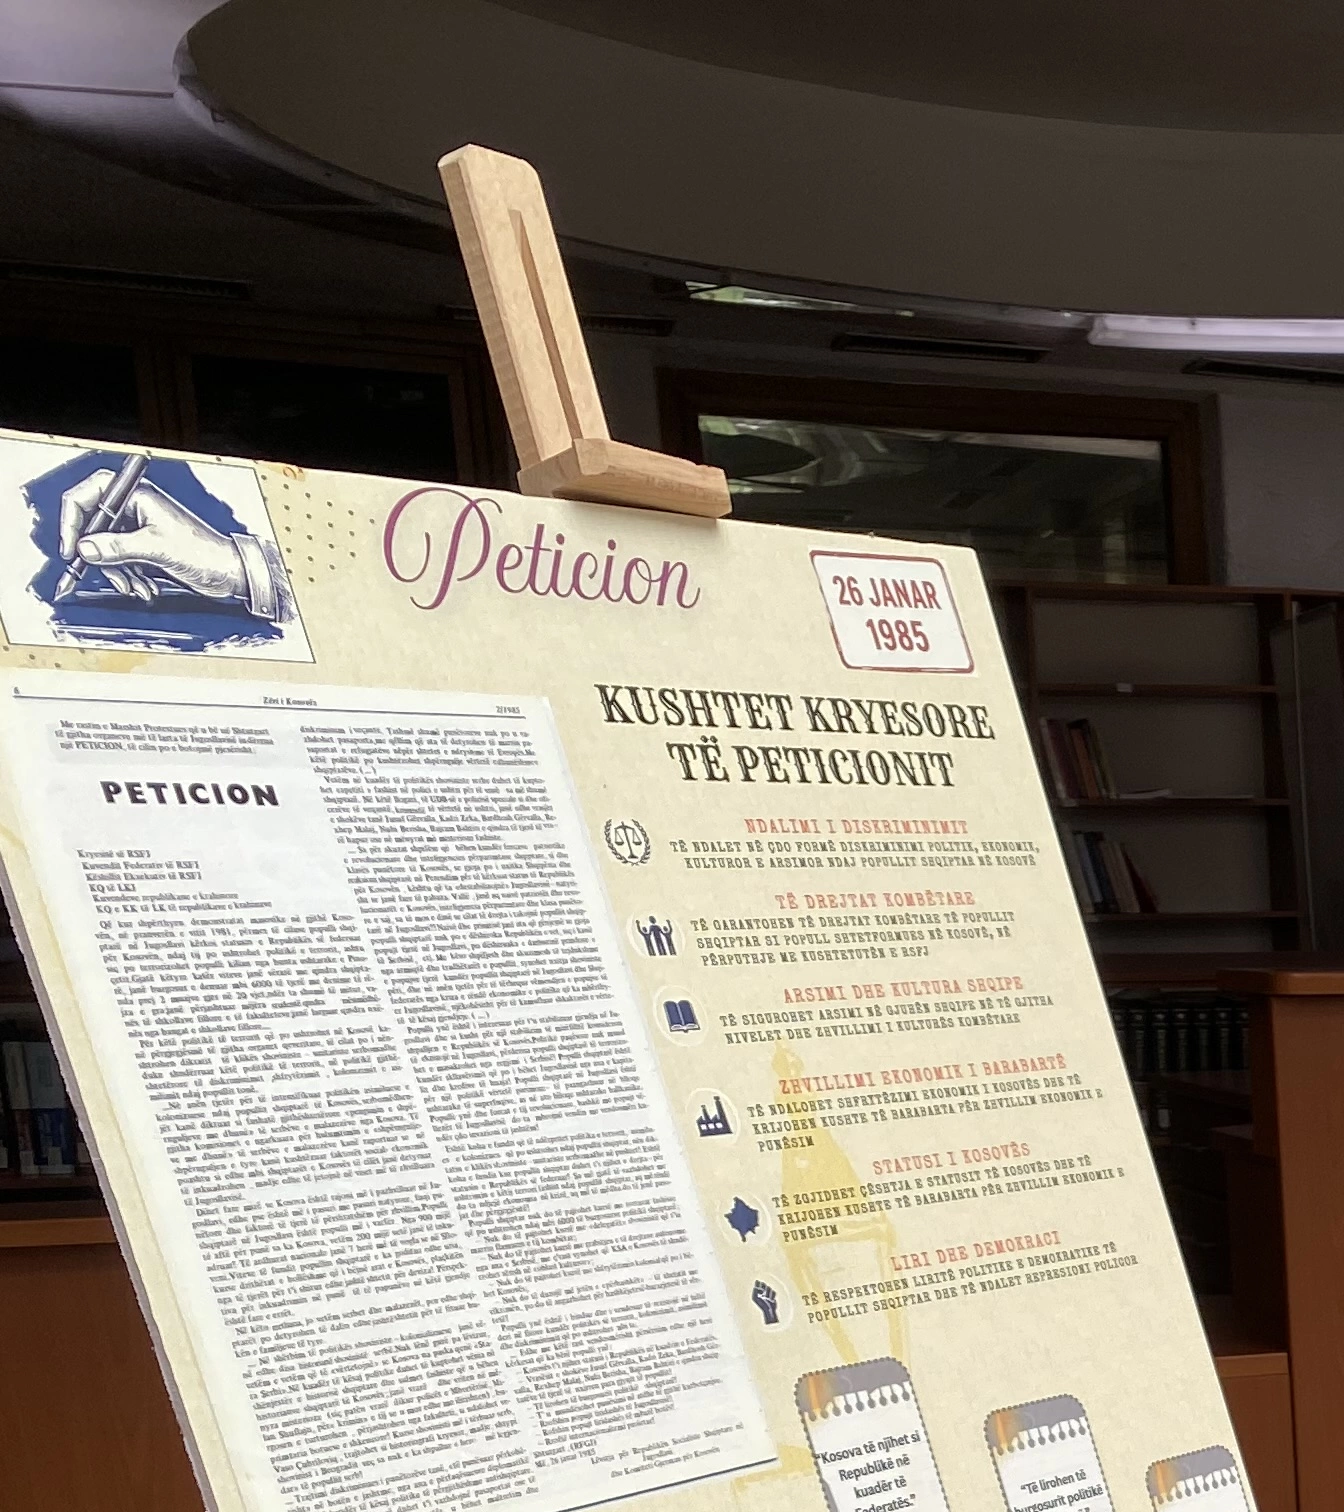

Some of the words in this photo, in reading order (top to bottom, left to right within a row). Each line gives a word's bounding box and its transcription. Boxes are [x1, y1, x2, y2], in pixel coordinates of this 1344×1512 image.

[383, 487, 698, 608] Peticion
[832, 575, 863, 605] 26
[869, 577, 940, 609] JANAR
[866, 618, 929, 651] 1985
[596, 684, 792, 730] KUSHTET
[802, 696, 994, 738] KRYESORE
[666, 735, 729, 782] TË
[734, 745, 953, 786] PETICIONIT
[101, 781, 277, 805] PETICION
[744, 818, 820, 833] NDALIMI
[825, 818, 836, 833] I
[841, 819, 967, 834] DISKRIMINIMIT
[668, 839, 688, 852] TË
[691, 840, 741, 852] NDALET
[745, 839, 763, 852] NË
[767, 841, 791, 854] ÇDO
[794, 839, 836, 852] FORMË
[839, 841, 924, 852] DISKRIMINIMI
[927, 841, 978, 853] POLITIK,
[980, 841, 1039, 856] EKONOMIK,
[774, 891, 798, 909] TË
[804, 892, 877, 909] DREJTAT
[883, 889, 975, 907] KOMBËTARE
[783, 985, 846, 1003] ARSIMI
[851, 983, 885, 999] DHE
[890, 979, 962, 996] KULTURA
[966, 976, 1023, 992] SHQIPE
[778, 1071, 875, 1094] ZHVILLIMI
[880, 1064, 963, 1085] EKONOMIK
[966, 1062, 977, 1077] I
[982, 1053, 1066, 1075] BARABARTË
[872, 1152, 942, 1175] STATUSI
[946, 1151, 957, 1166] I
[961, 1141, 1030, 1163] KOSOVËS
[890, 1251, 931, 1271] LIRI
[935, 1245, 968, 1263] DHE
[973, 1230, 1060, 1257] DEMOKRACI
[814, 1447, 863, 1467] “Kosova
[862, 1440, 876, 1453] të
[877, 1434, 910, 1452] njihet
[910, 1429, 920, 1442] si
[838, 1457, 894, 1481] Republikë
[895, 1453, 910, 1467] në
[1020, 1481, 1038, 1494] “Të
[1038, 1474, 1075, 1490] lirohen
[1074, 1468, 1086, 1481] të
[853, 1479, 892, 1498] kuadër
[893, 1475, 907, 1488] të
[1066, 1483, 1103, 1506] politikë
